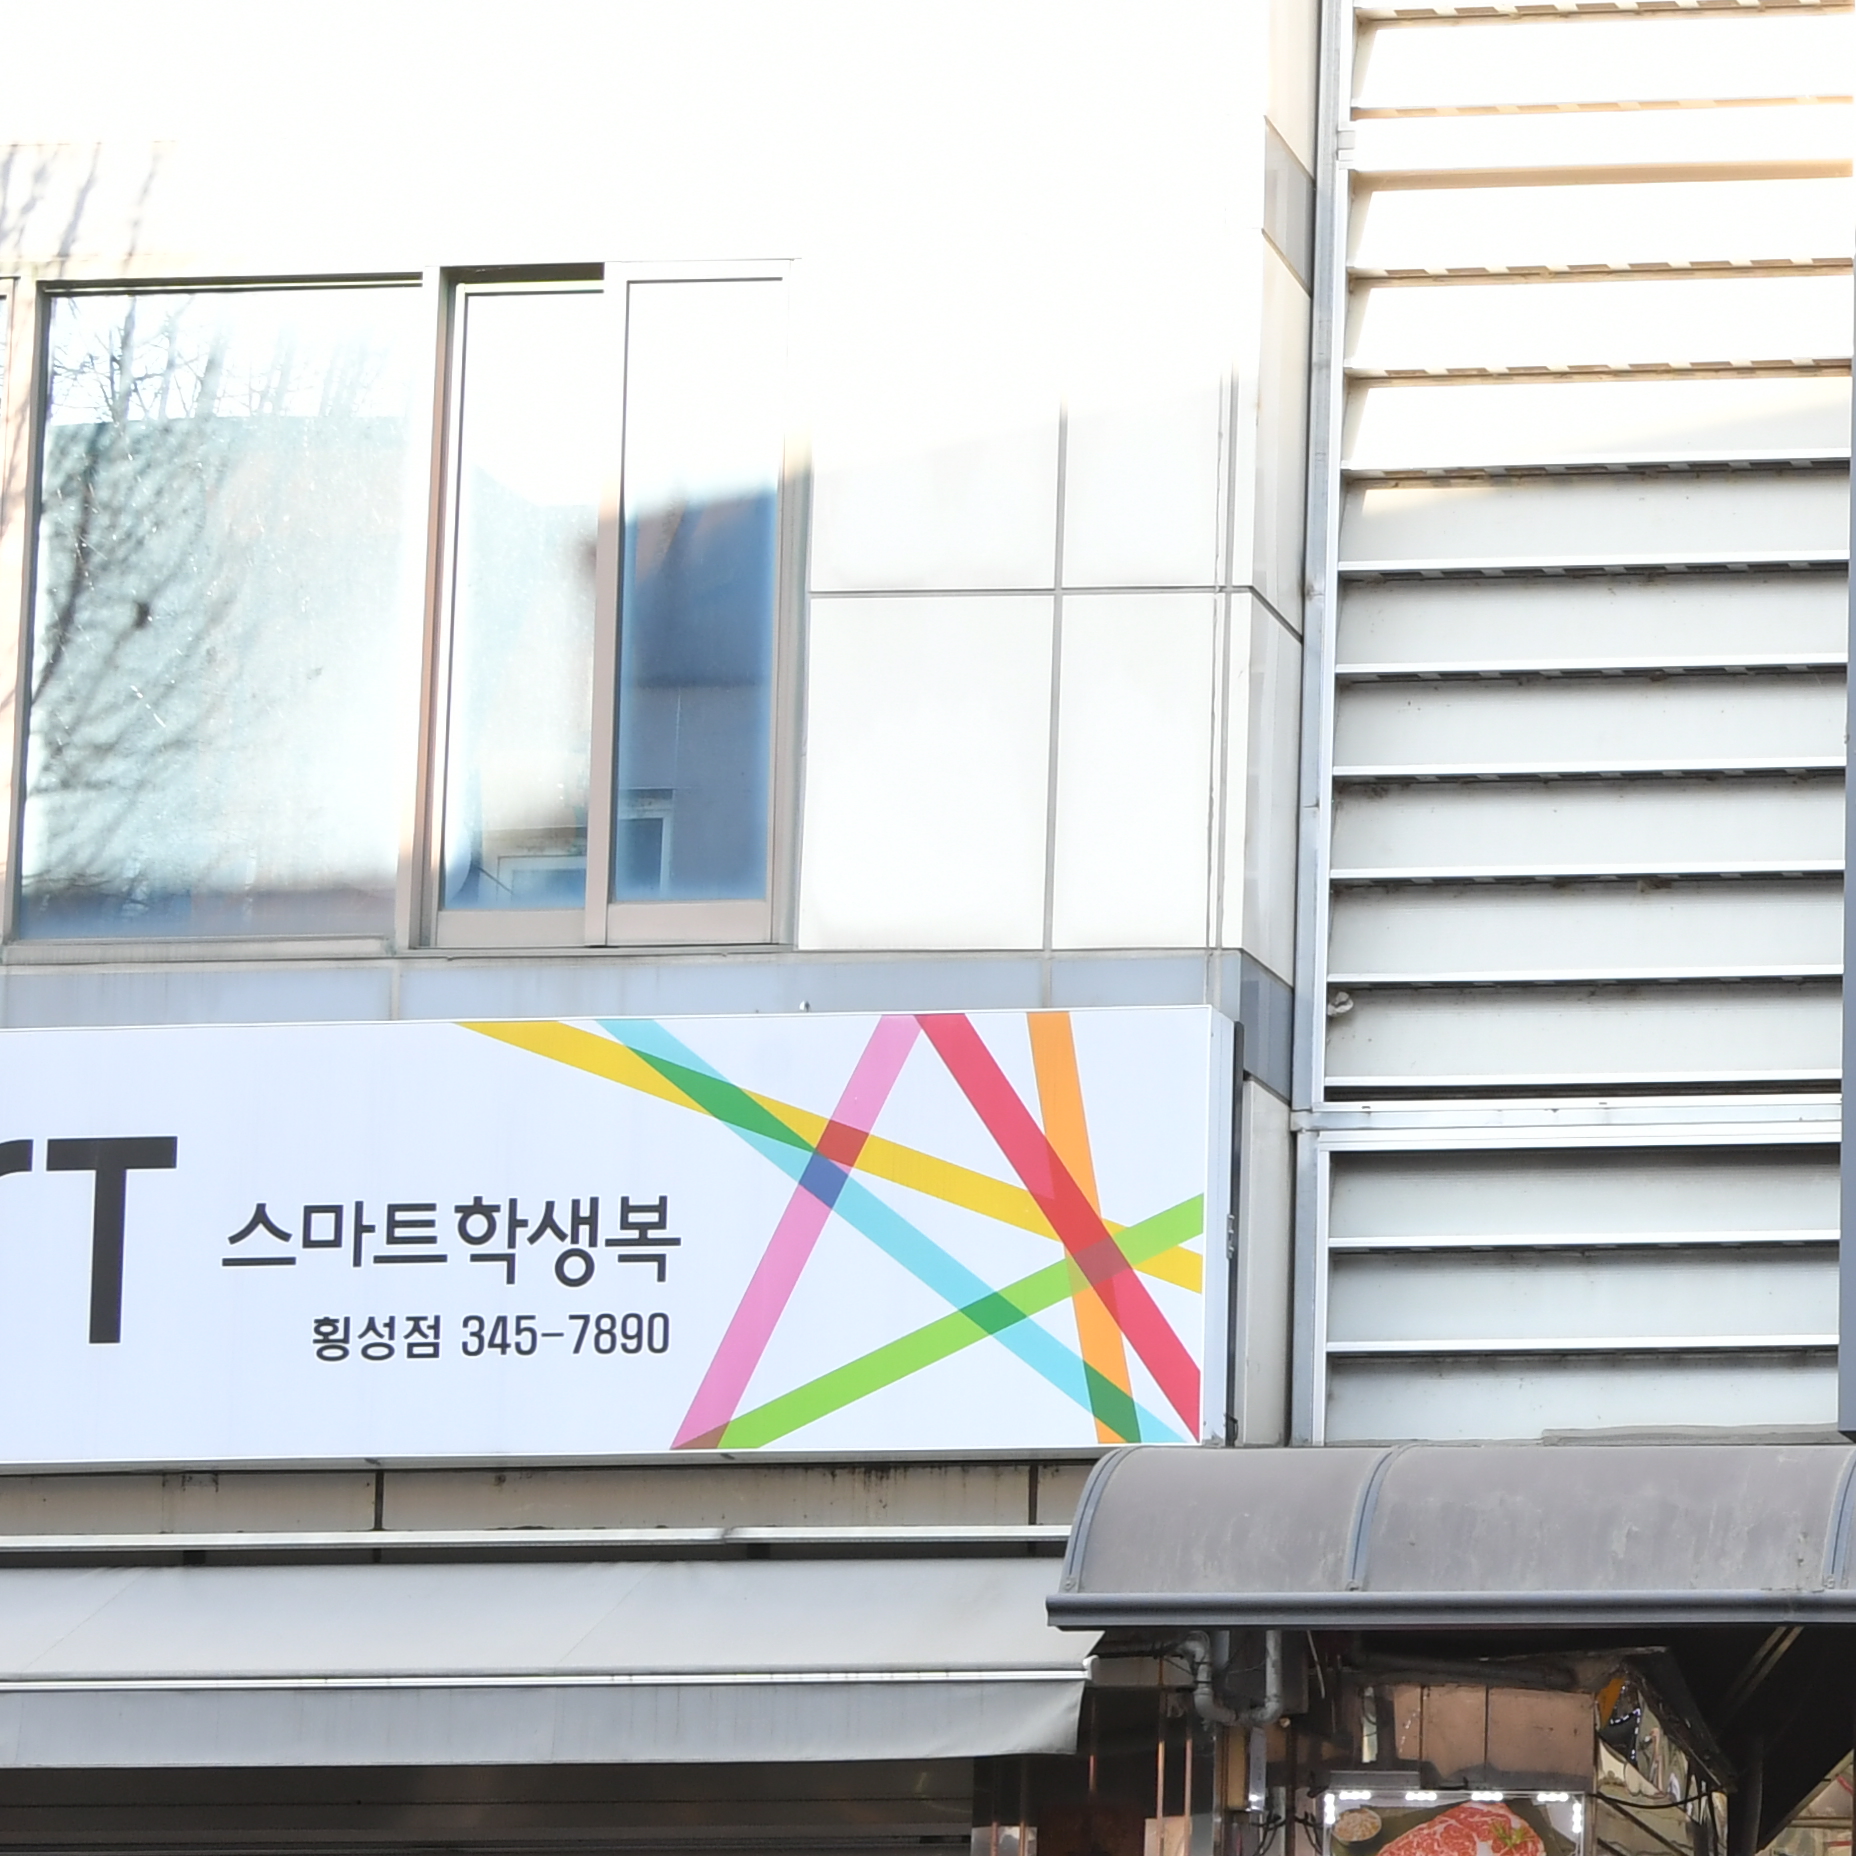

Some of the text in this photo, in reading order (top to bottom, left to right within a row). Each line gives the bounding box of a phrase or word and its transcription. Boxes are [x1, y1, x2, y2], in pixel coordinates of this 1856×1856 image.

[221, 1194, 682, 1288] 스마트학생복
[311, 1310, 672, 1363] 횡성점 345-7890
